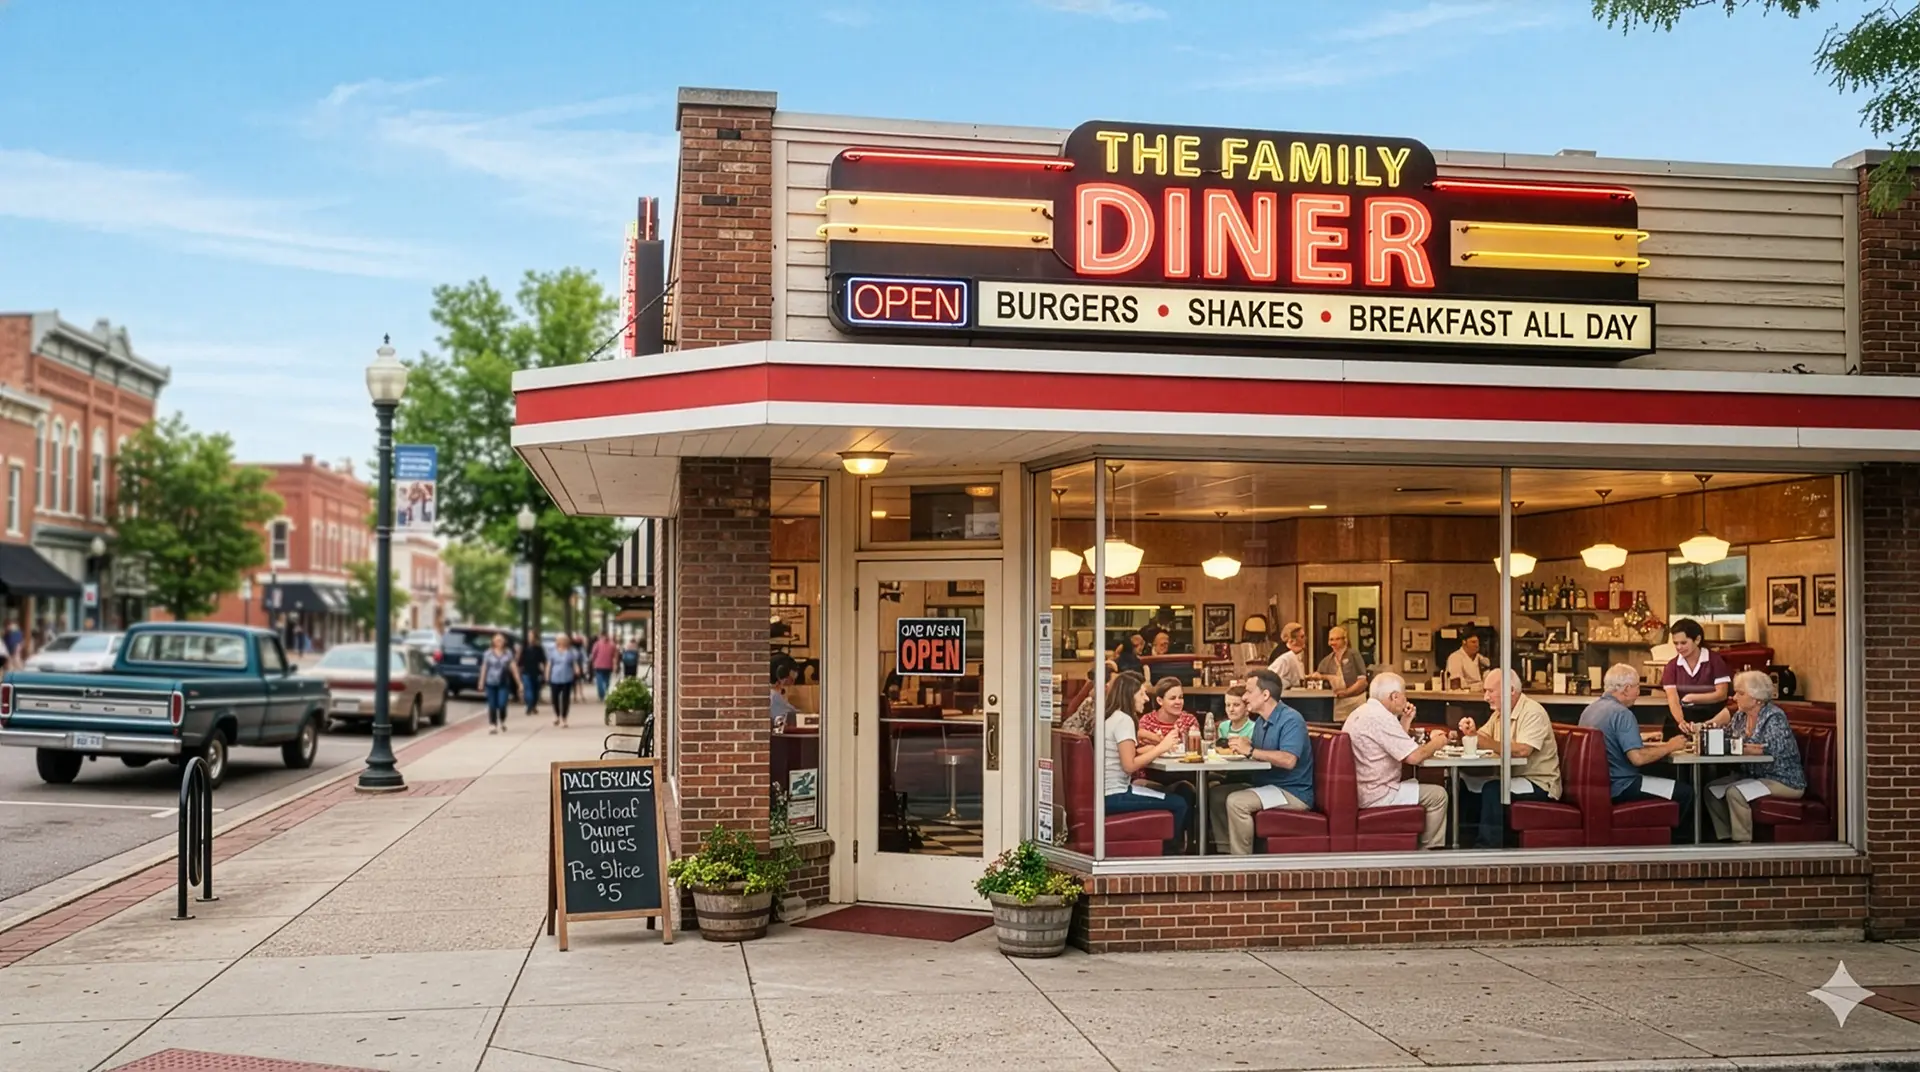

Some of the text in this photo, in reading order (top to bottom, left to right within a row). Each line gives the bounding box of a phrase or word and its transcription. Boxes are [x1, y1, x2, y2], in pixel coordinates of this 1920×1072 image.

[1096, 131, 1411, 187] THE FAMILY
[1075, 182, 1435, 288] DINER
[854, 284, 960, 321] OPEN
[997, 291, 1638, 341] BURGERS SHAKES BREAKFAST ALL DAY
[902, 638, 960, 670] OPEN
